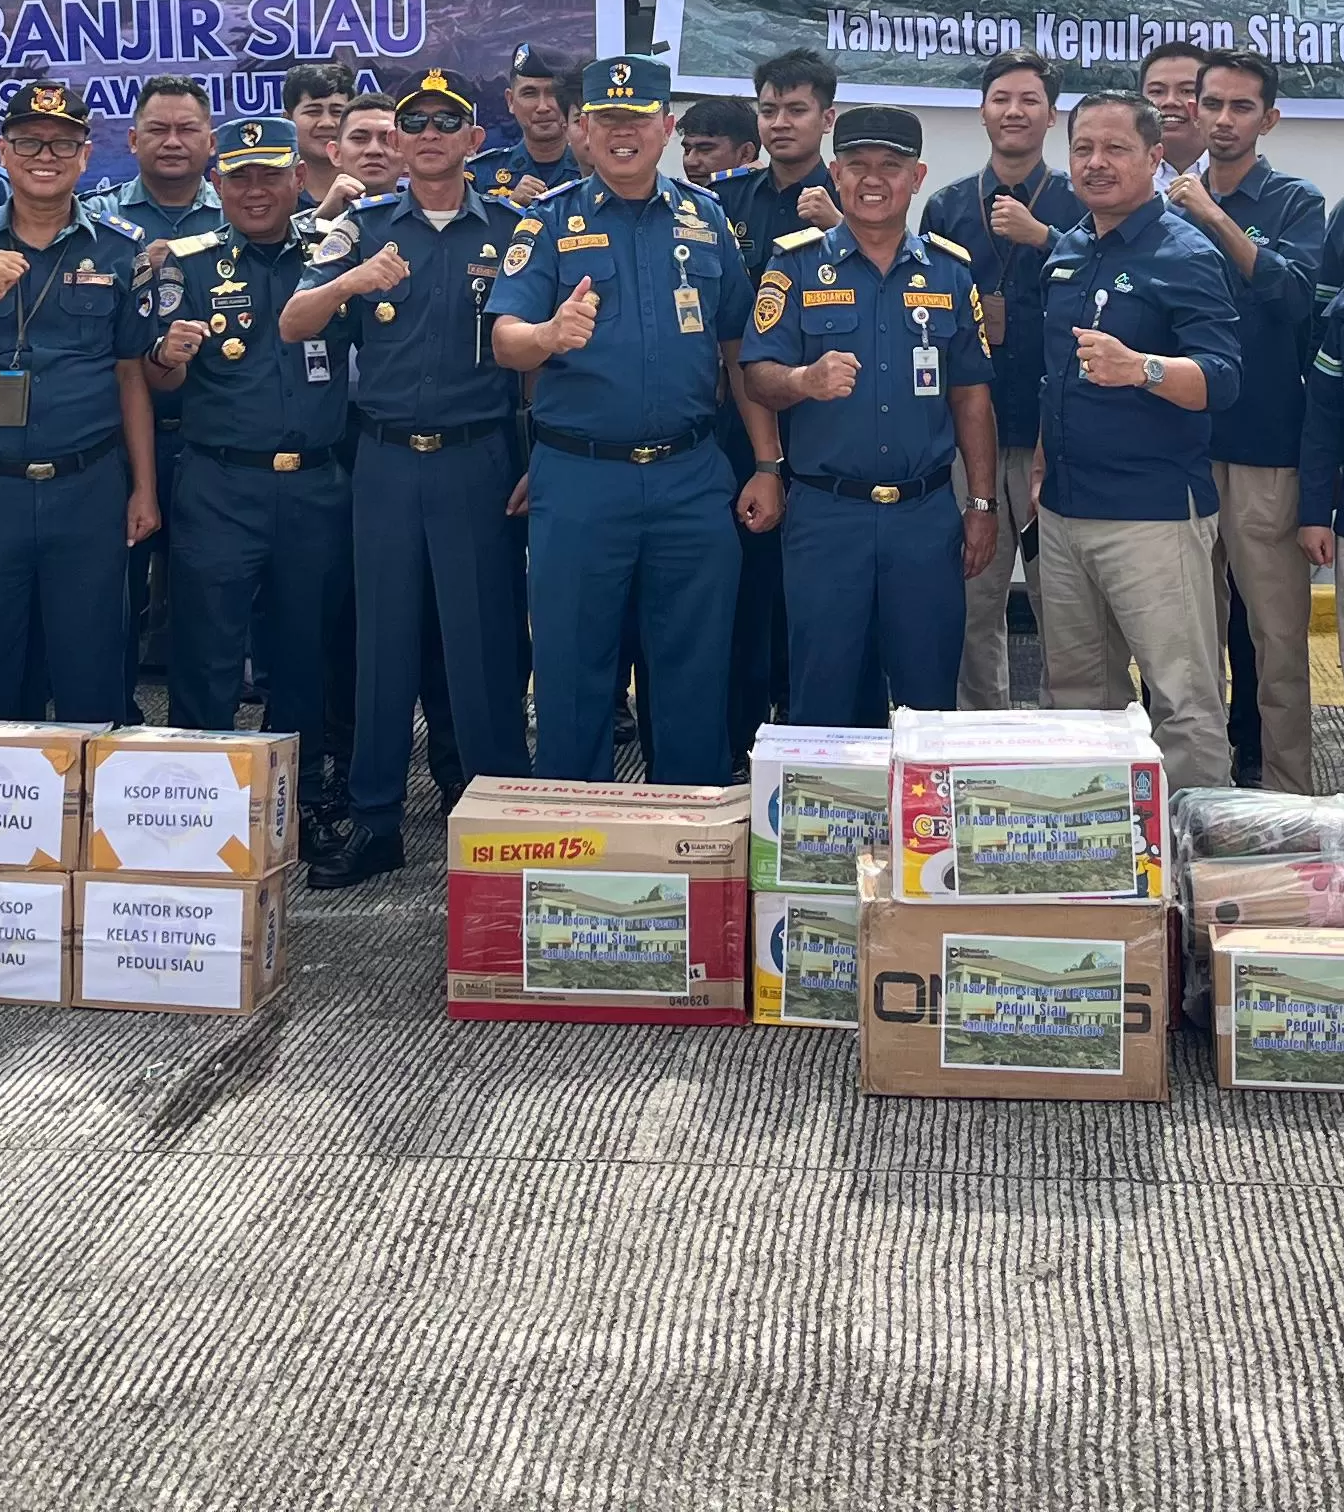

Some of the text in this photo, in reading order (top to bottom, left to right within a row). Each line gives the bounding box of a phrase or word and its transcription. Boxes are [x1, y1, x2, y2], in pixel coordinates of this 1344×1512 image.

[826, 8, 1022, 61] Kabupaten
[1035, 12, 1235, 68] Kepulauan
[123, 785, 219, 800] KSOP BITUNG
[274, 774, 286, 838] ASEGAR
[127, 813, 213, 828] PEDULI SIAU
[1007, 830, 1078, 845] Peduli Siau
[473, 838, 596, 863] ISI EXTRA 15%
[112, 902, 214, 920] KANTOR KSOP
[106, 928, 216, 946] KELAS I BITUNG
[263, 907, 277, 972] ASEGAR
[572, 931, 607, 946] Peduli
[117, 955, 205, 973] PEDULI SIAU
[995, 1001, 1067, 1018] Peduli Siau
[1286, 1019, 1325, 1034] Peduli
